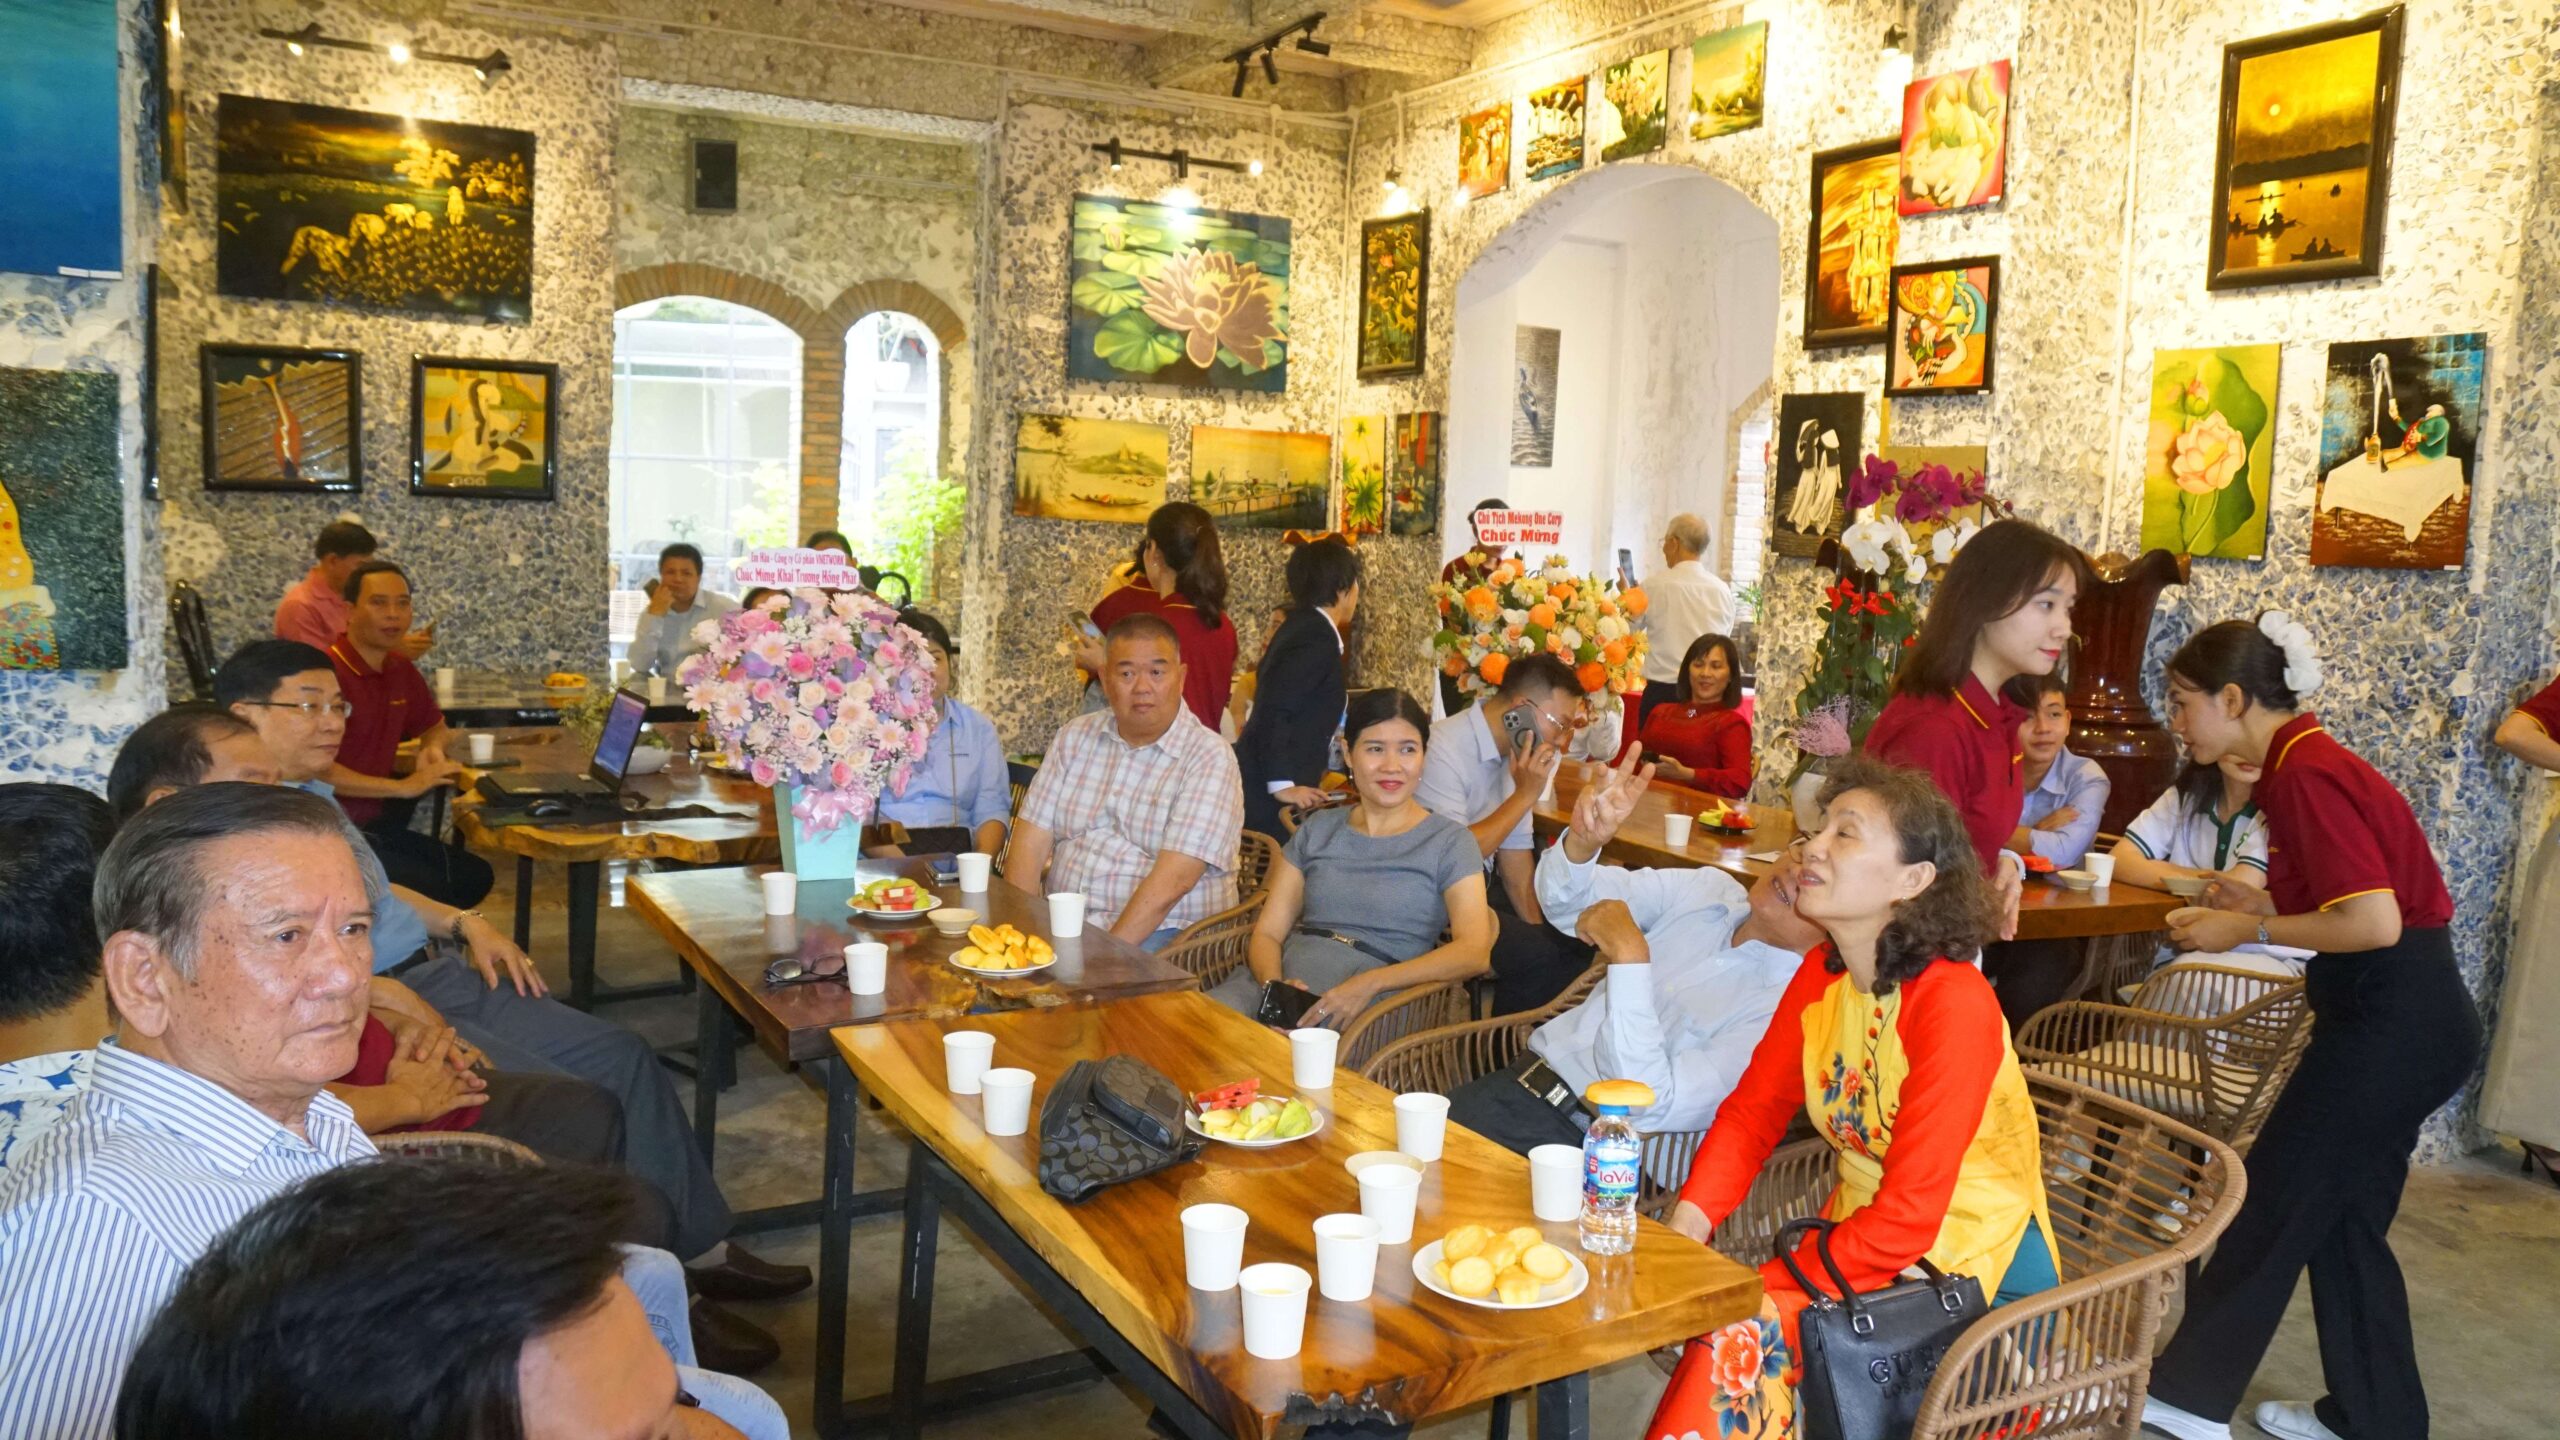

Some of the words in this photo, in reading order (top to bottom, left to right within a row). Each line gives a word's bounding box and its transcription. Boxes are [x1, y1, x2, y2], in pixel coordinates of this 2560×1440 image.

[1508, 511, 1532, 527] Mekong
[1535, 511, 1546, 525] One
[1548, 511, 1562, 527] Corp
[1481, 529, 1515, 542] Chúc
[1521, 529, 1559, 545] Mừng
[778, 567, 793, 582] Khai
